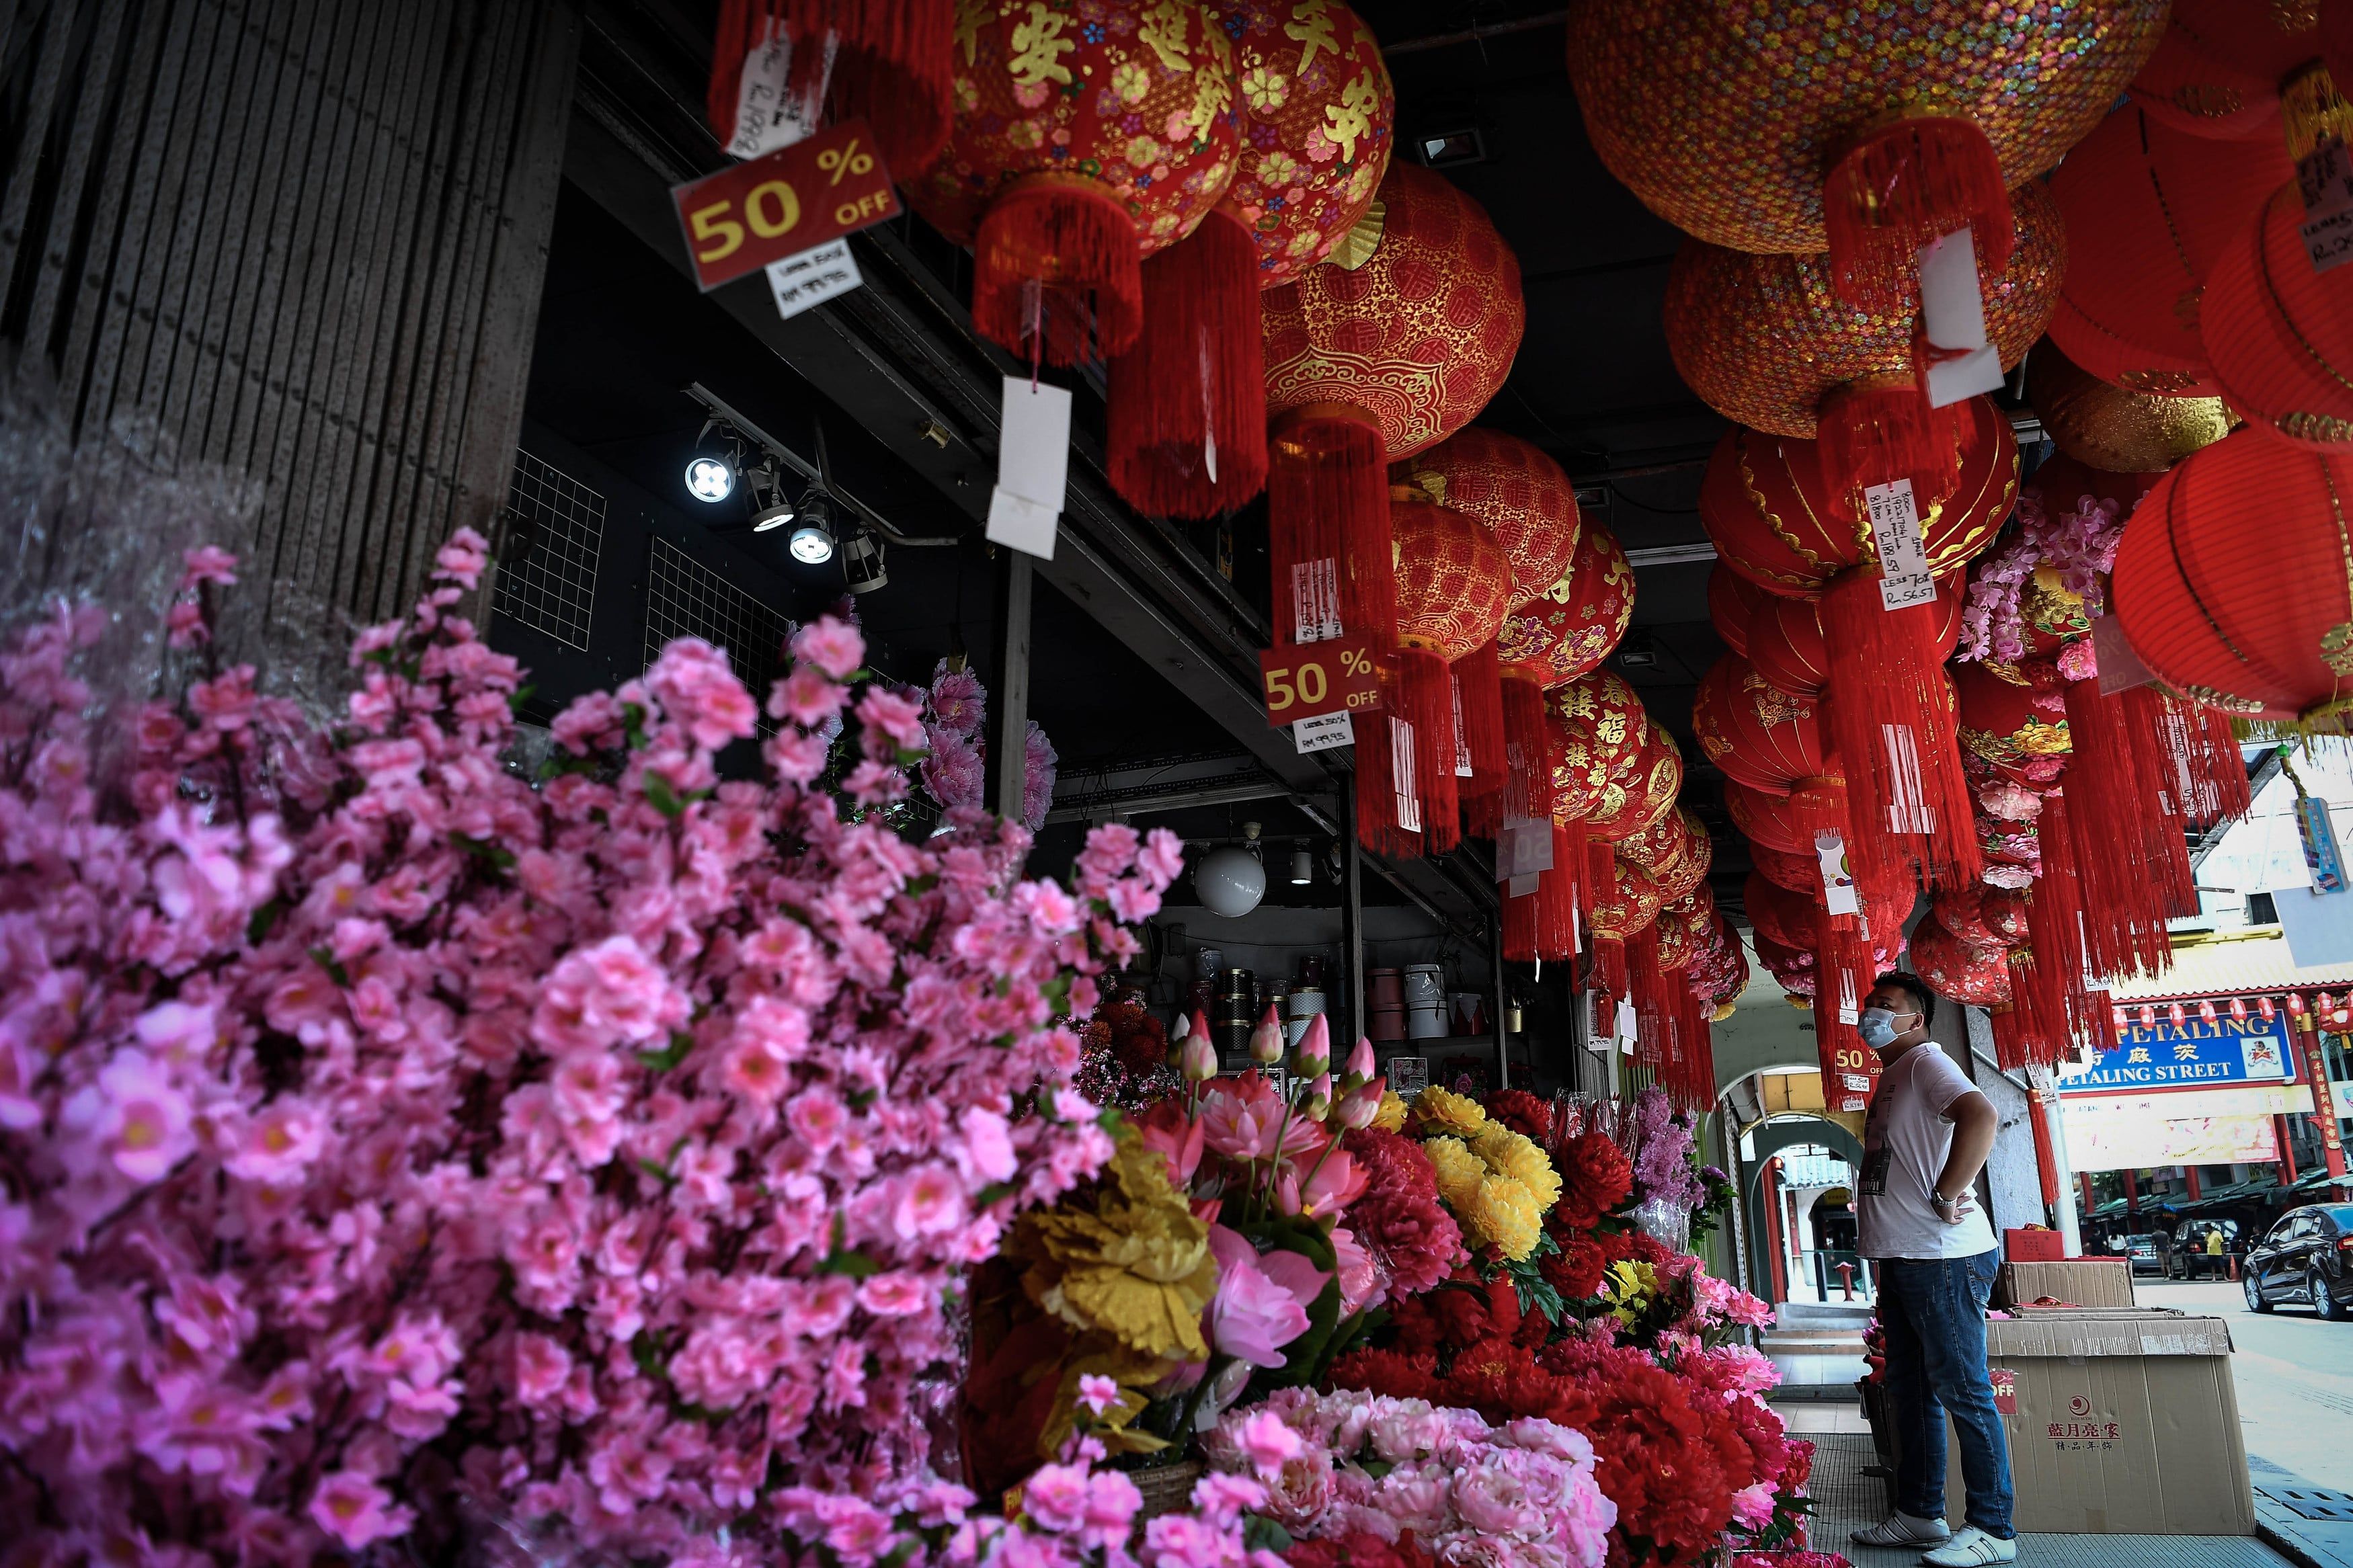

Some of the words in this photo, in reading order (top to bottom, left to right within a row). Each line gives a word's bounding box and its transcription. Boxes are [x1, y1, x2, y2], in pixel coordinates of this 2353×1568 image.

[834, 190, 891, 225] OFF
[690, 180, 801, 263] 50
[1884, 577, 1907, 588] LESS
[1909, 573, 1930, 587] 70%
[1266, 663, 1327, 710] 50
[1346, 690, 1378, 708] OFF
[2117, 1016, 2270, 1044] PETALING
[1837, 1049, 1863, 1069] 50
[2057, 1065, 2151, 1087] PETALING
[2156, 1061, 2231, 1081] STREET
